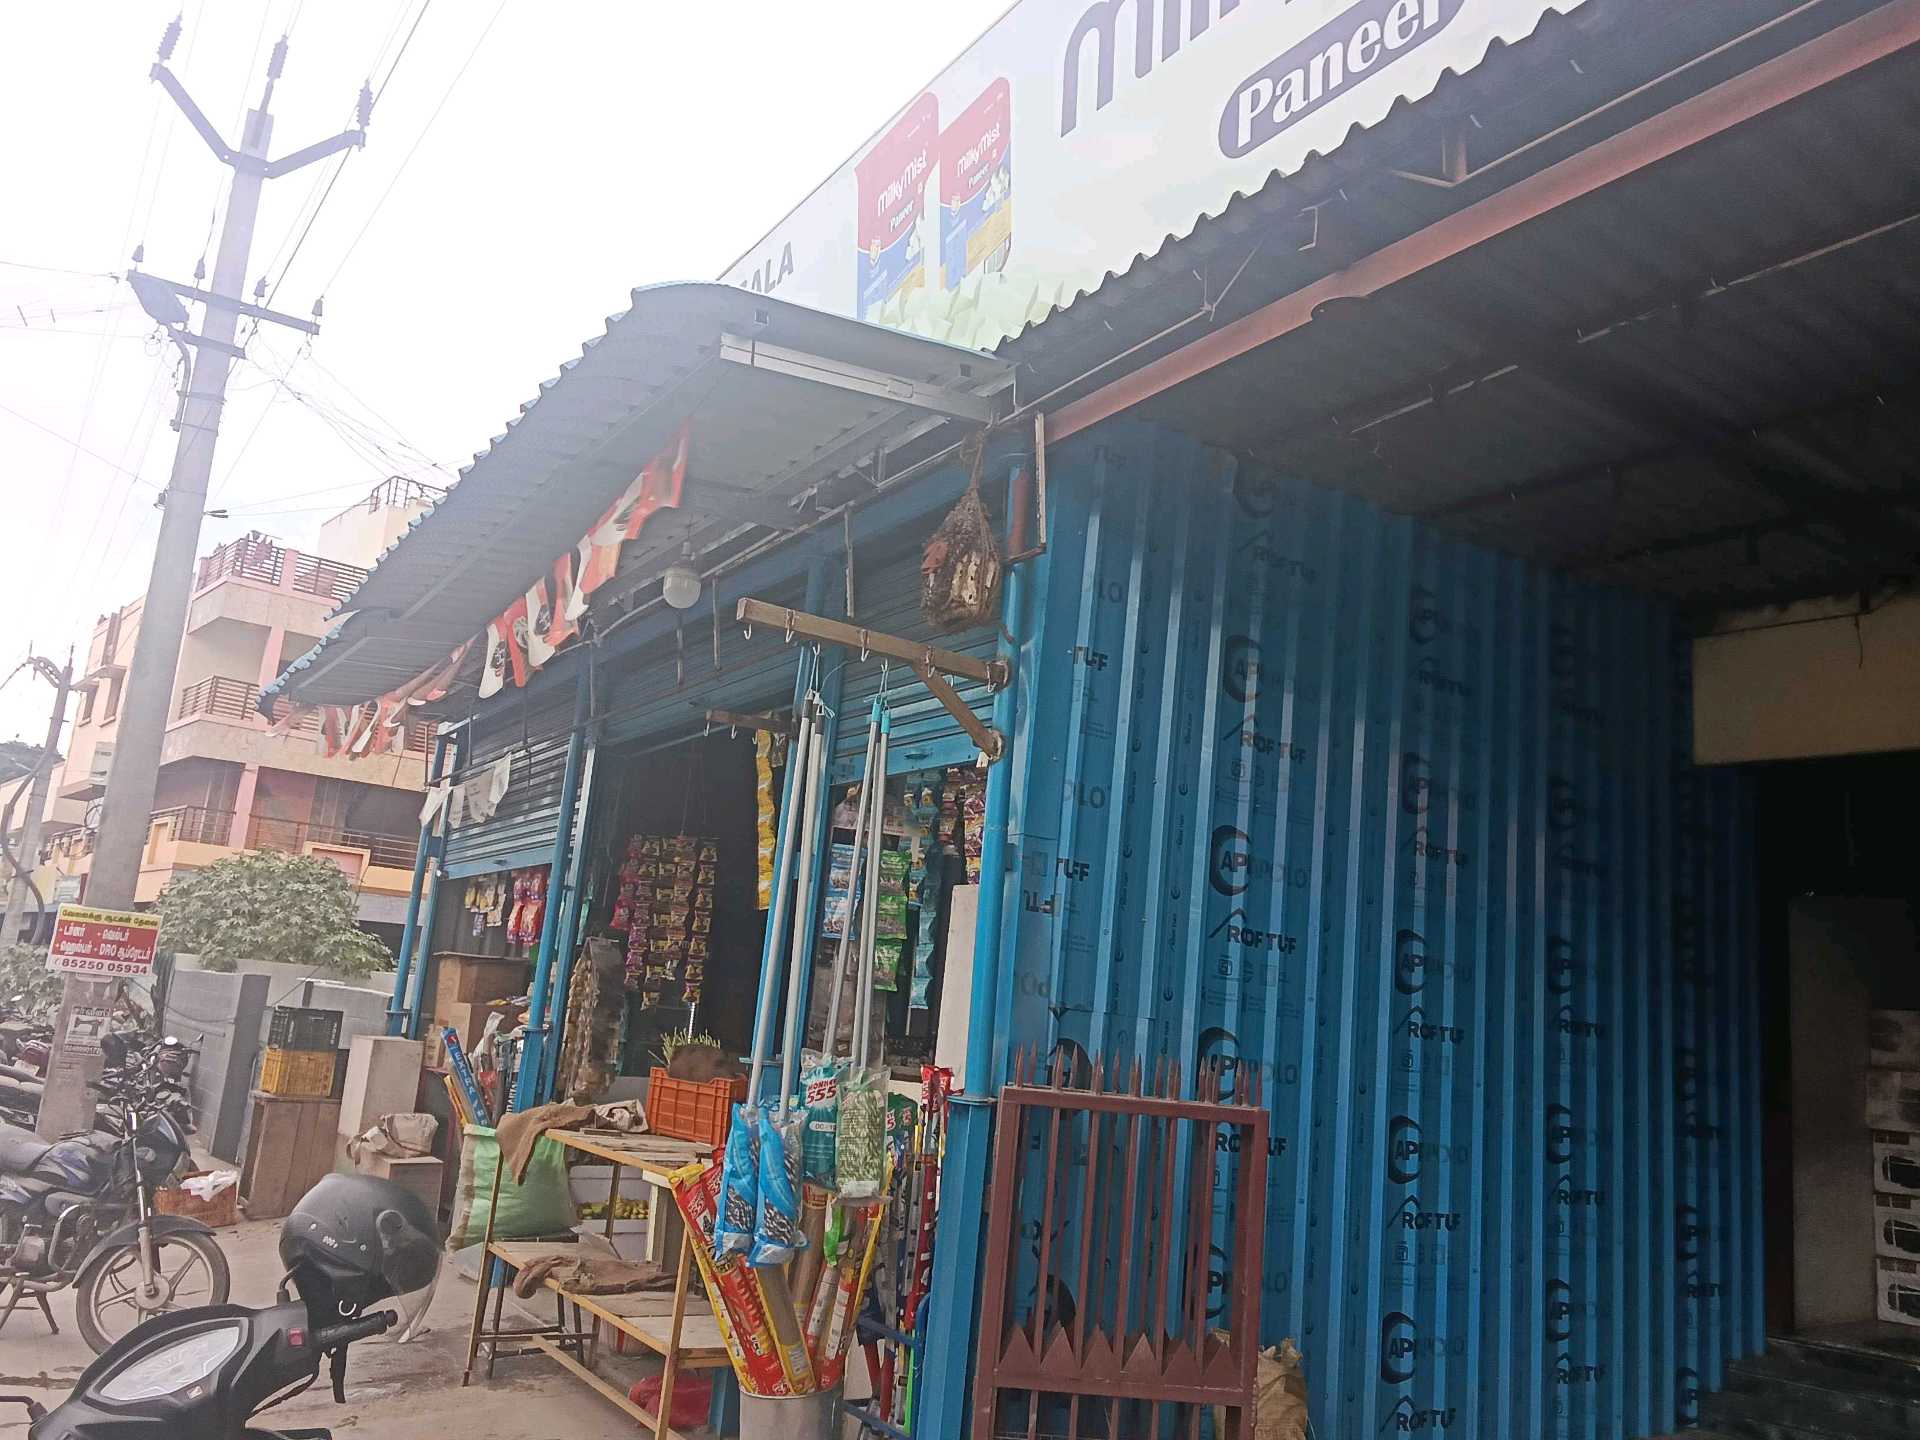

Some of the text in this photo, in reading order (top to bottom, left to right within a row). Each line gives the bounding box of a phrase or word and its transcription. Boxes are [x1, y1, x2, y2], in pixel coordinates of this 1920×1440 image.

[61, 958, 149, 975] 85250 05934
[806, 1085, 837, 1104] 555
